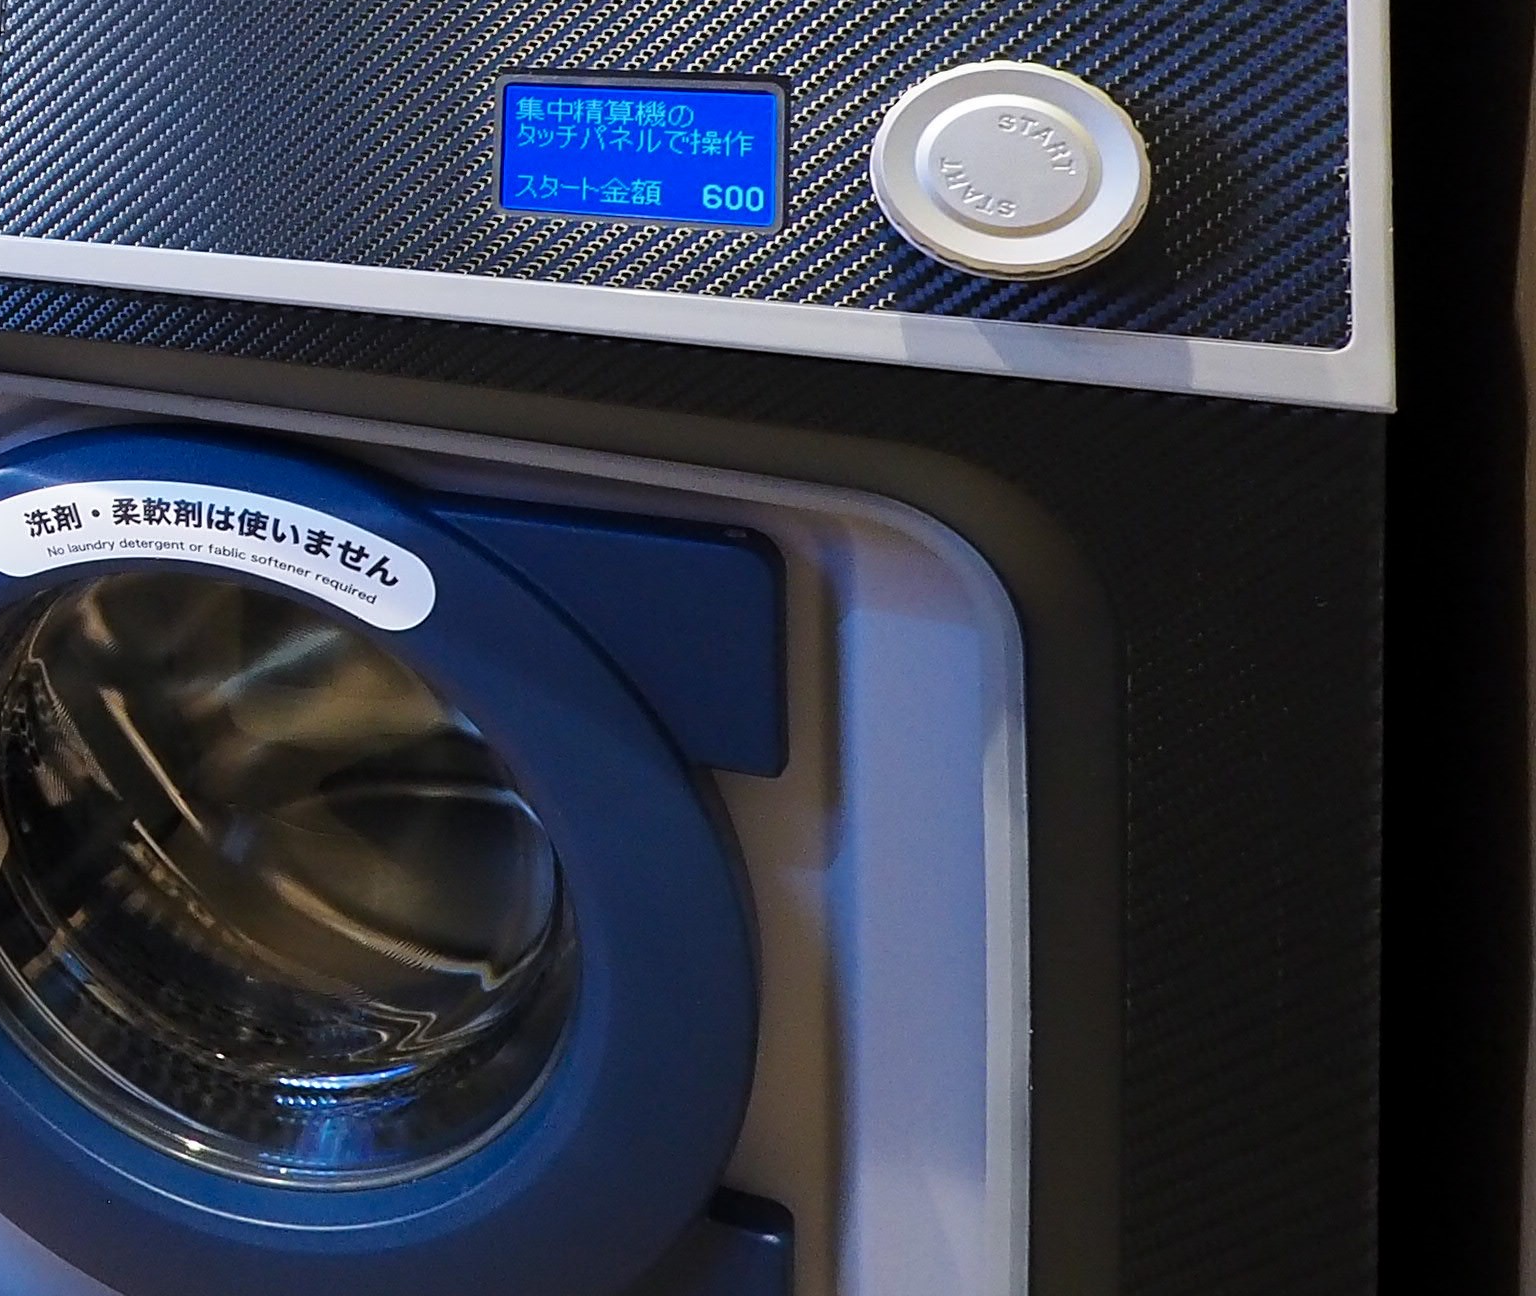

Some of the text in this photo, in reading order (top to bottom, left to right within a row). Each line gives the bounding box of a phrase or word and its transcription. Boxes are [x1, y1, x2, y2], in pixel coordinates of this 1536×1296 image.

[515, 96, 695, 128] 集中精算機の
[517, 123, 755, 157] タッチパネルで操作
[997, 113, 1076, 176] START
[515, 174, 765, 212] スタート金額 600
[939, 157, 1017, 218] START
[24, 497, 399, 587] 洗剤・柔軟剤は使いません
[47, 538, 378, 605] No laundry detergent or fablic softener required
